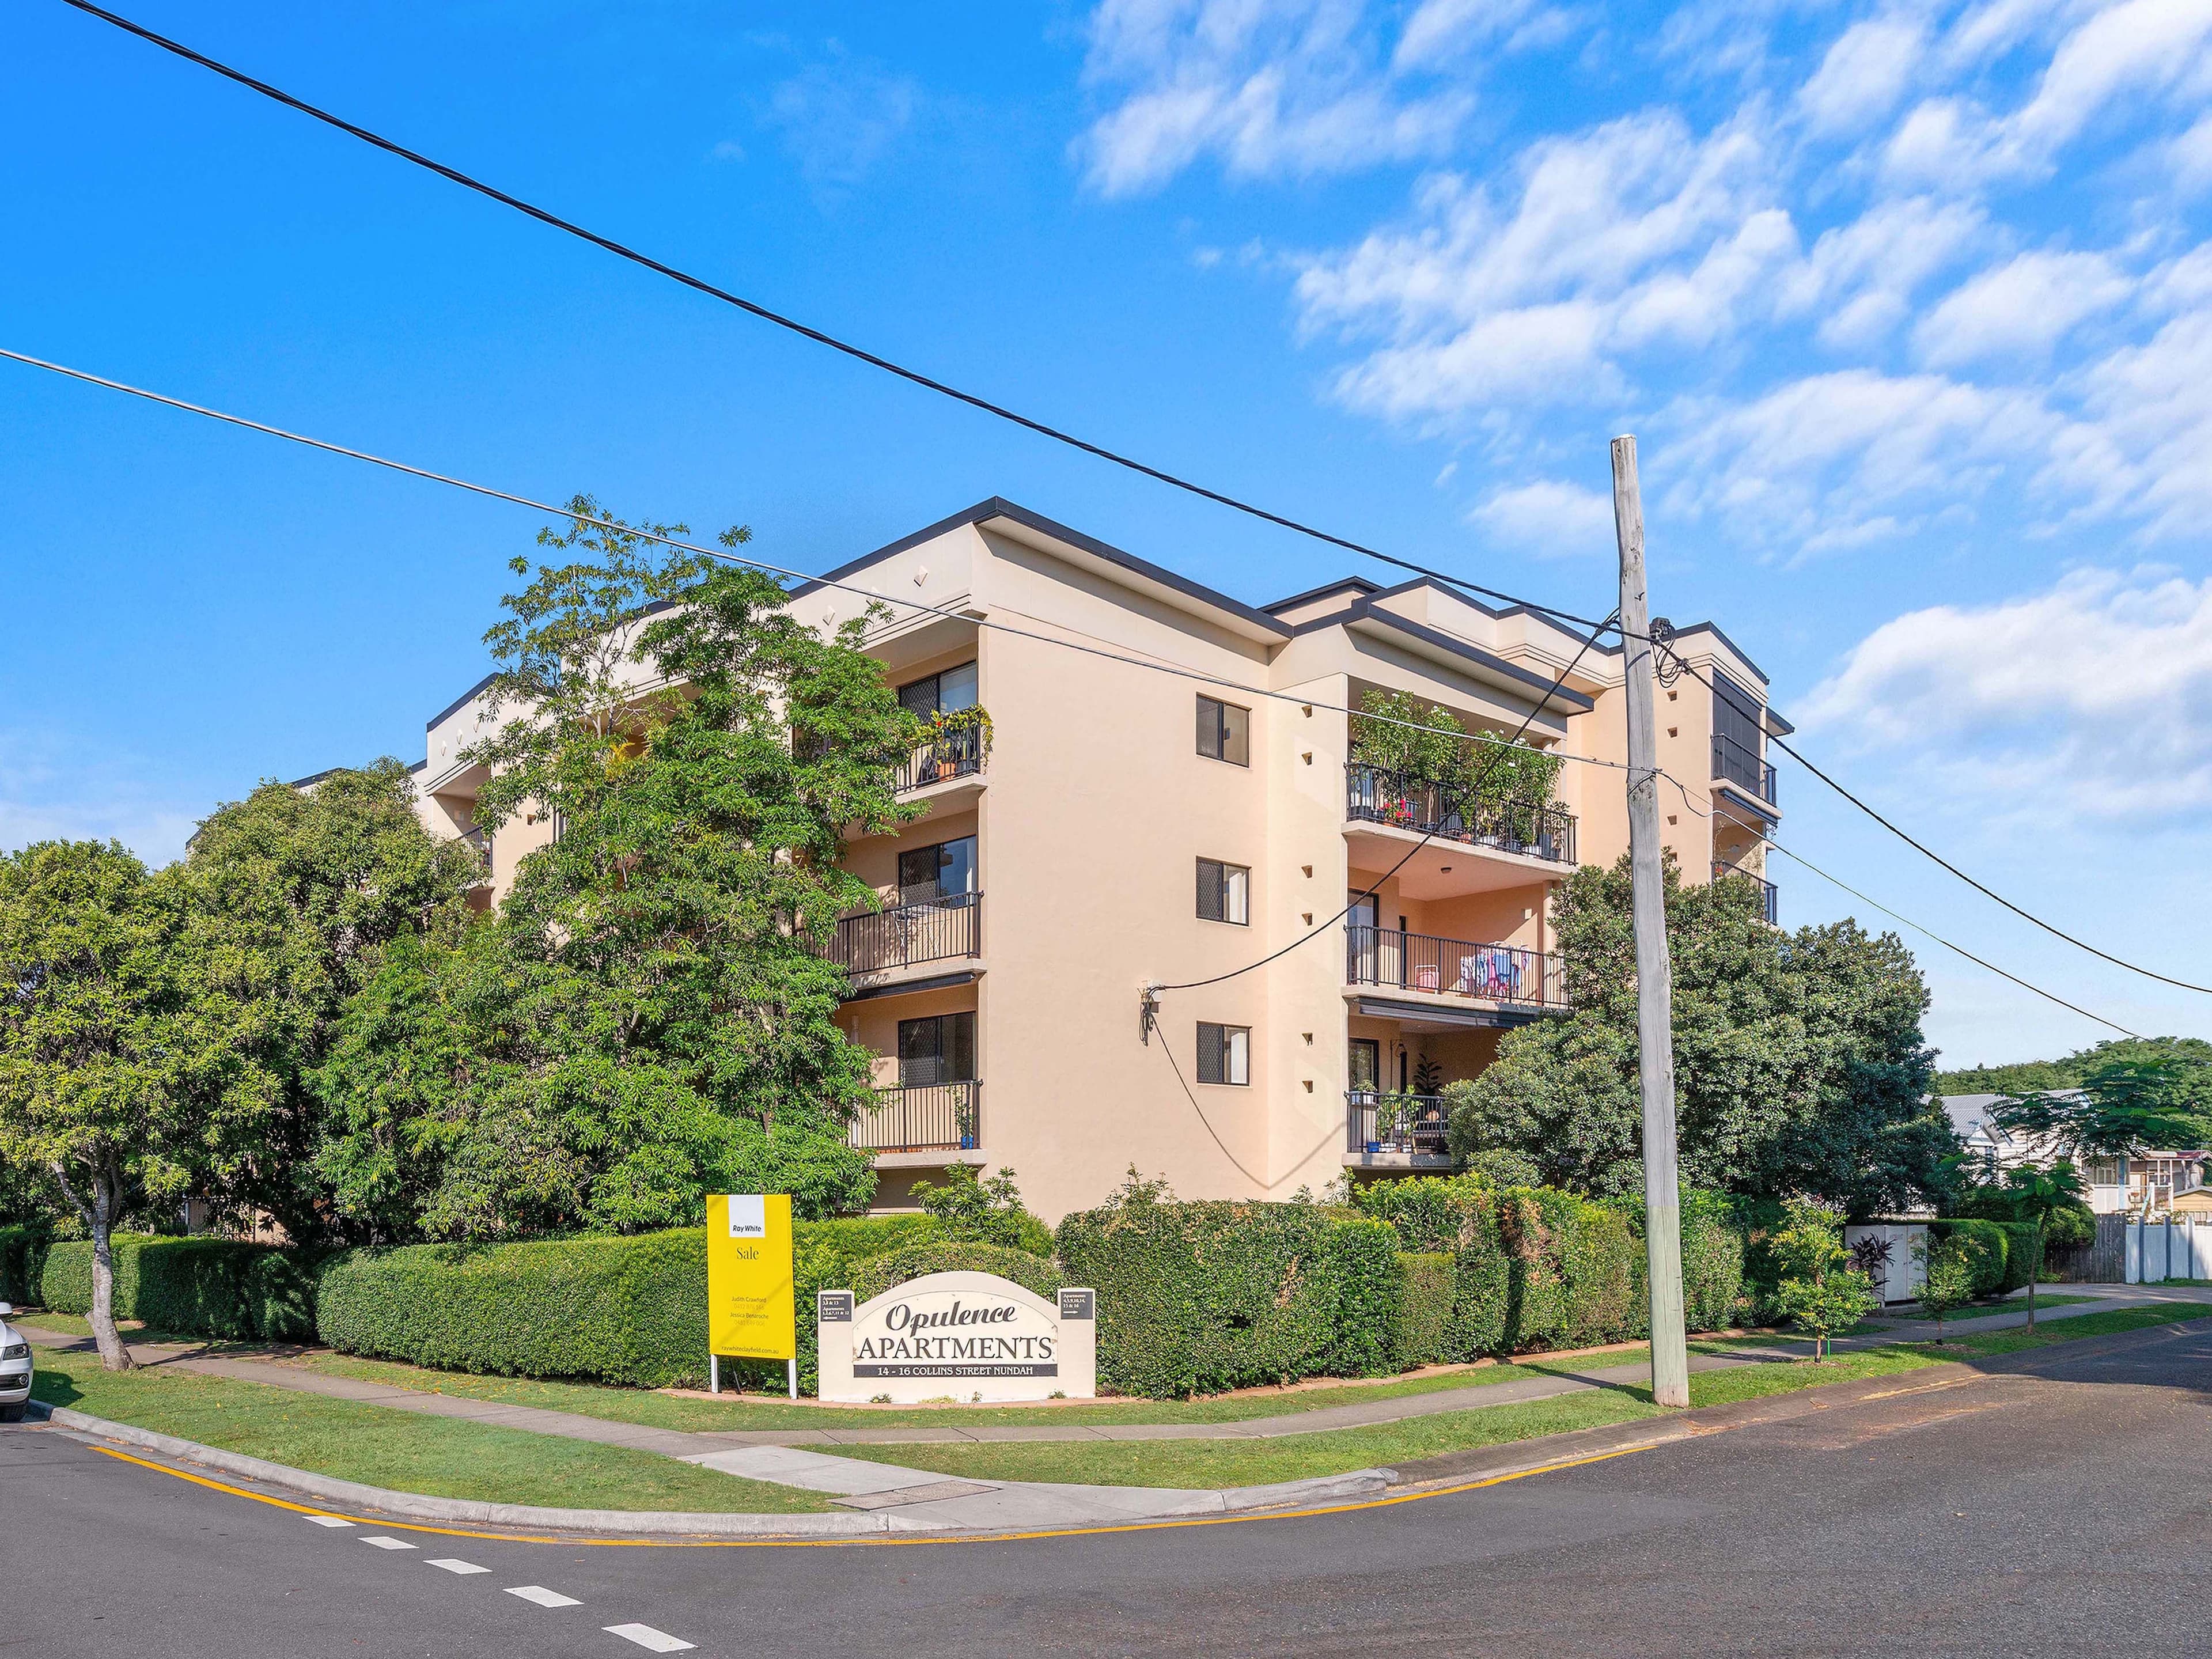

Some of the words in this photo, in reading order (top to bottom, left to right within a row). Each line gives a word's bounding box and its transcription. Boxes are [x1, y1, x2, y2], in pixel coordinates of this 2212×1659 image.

[733, 1225, 744, 1233] Ray
[737, 1246, 759, 1260] Sale
[886, 1301, 1017, 1338] Opulence
[721, 1346, 779, 1354] raywhiteclayfield.com.au
[857, 1336, 1052, 1359] APARTMENTS
[877, 1367, 889, 1376] 14
[899, 1367, 910, 1376] 16
[912, 1367, 953, 1376] COLLINS
[956, 1366, 991, 1375] STREET
[994, 1366, 1033, 1375] NUNDAH
